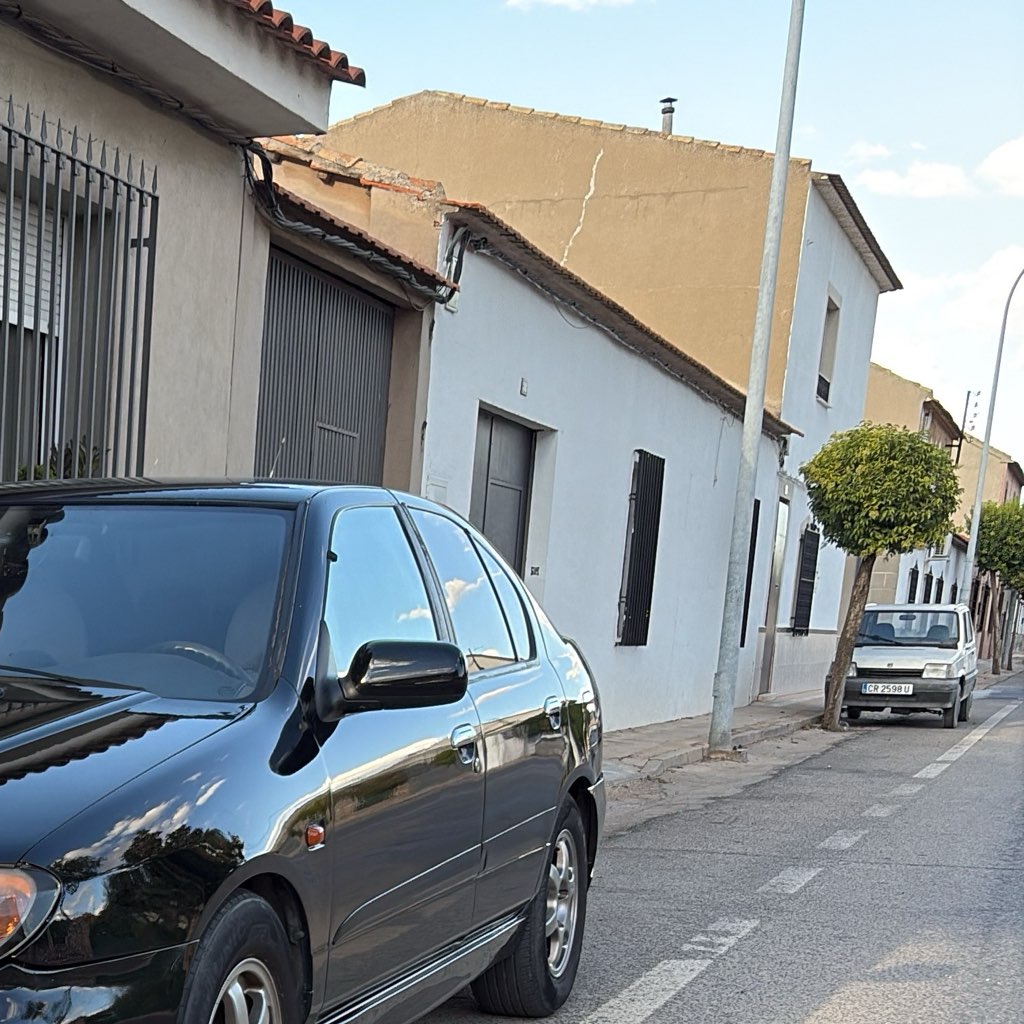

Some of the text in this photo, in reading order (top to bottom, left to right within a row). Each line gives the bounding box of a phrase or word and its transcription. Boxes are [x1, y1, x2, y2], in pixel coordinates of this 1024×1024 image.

[867, 684, 910, 693] CR 2598 U
